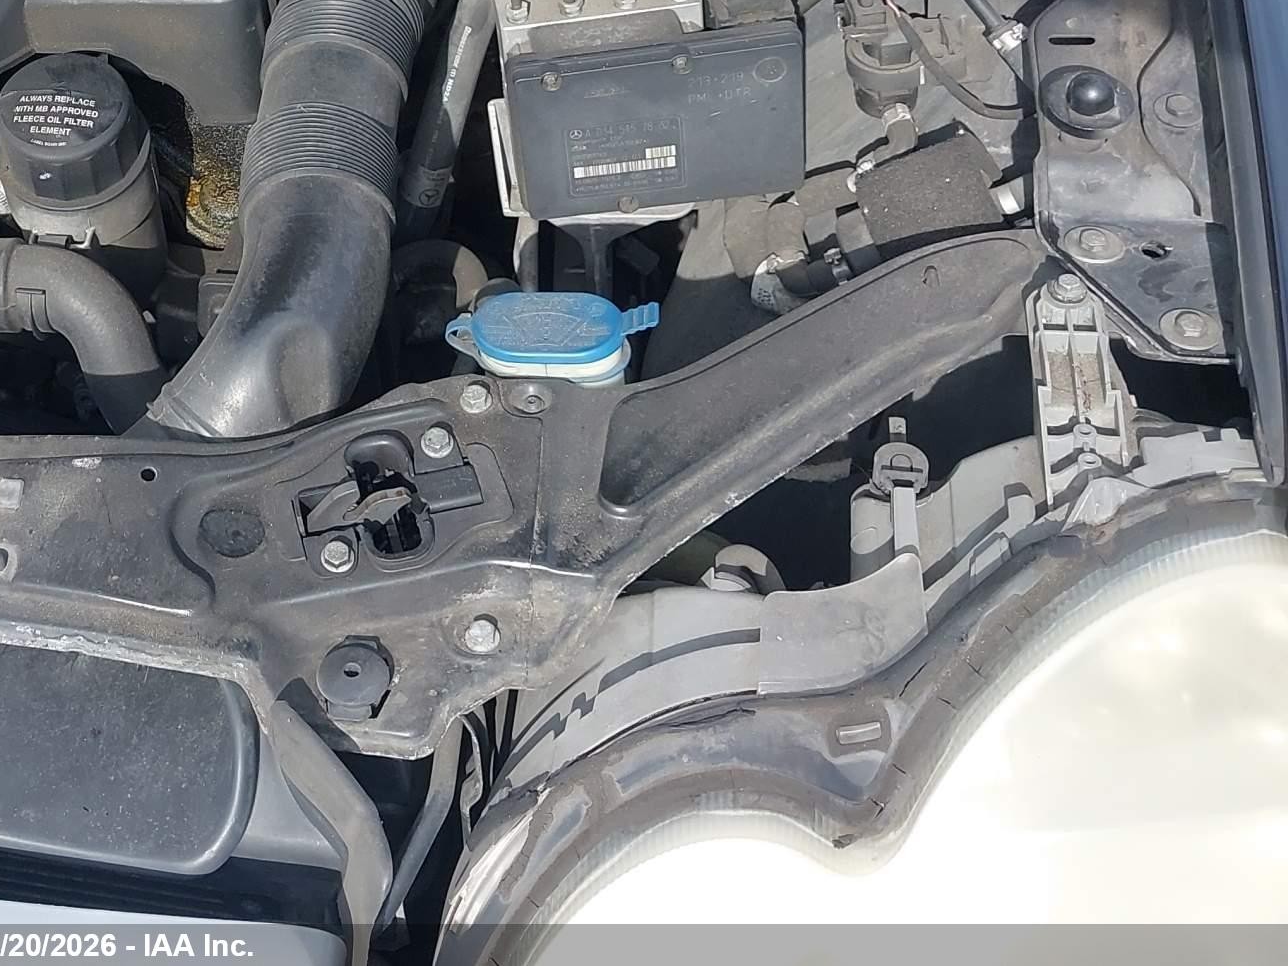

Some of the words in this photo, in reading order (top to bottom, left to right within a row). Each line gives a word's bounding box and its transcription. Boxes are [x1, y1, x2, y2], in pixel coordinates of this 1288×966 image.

[19, 94, 53, 103] ALWAYS
[54, 95, 96, 108] REPLACE
[34, 105, 49, 113] MB
[49, 106, 99, 118] APPROVED
[13, 115, 46, 123] FLEECE
[46, 116, 62, 124] OIL
[63, 117, 95, 128] FILTER
[29, 125, 72, 136] ELEMENT
